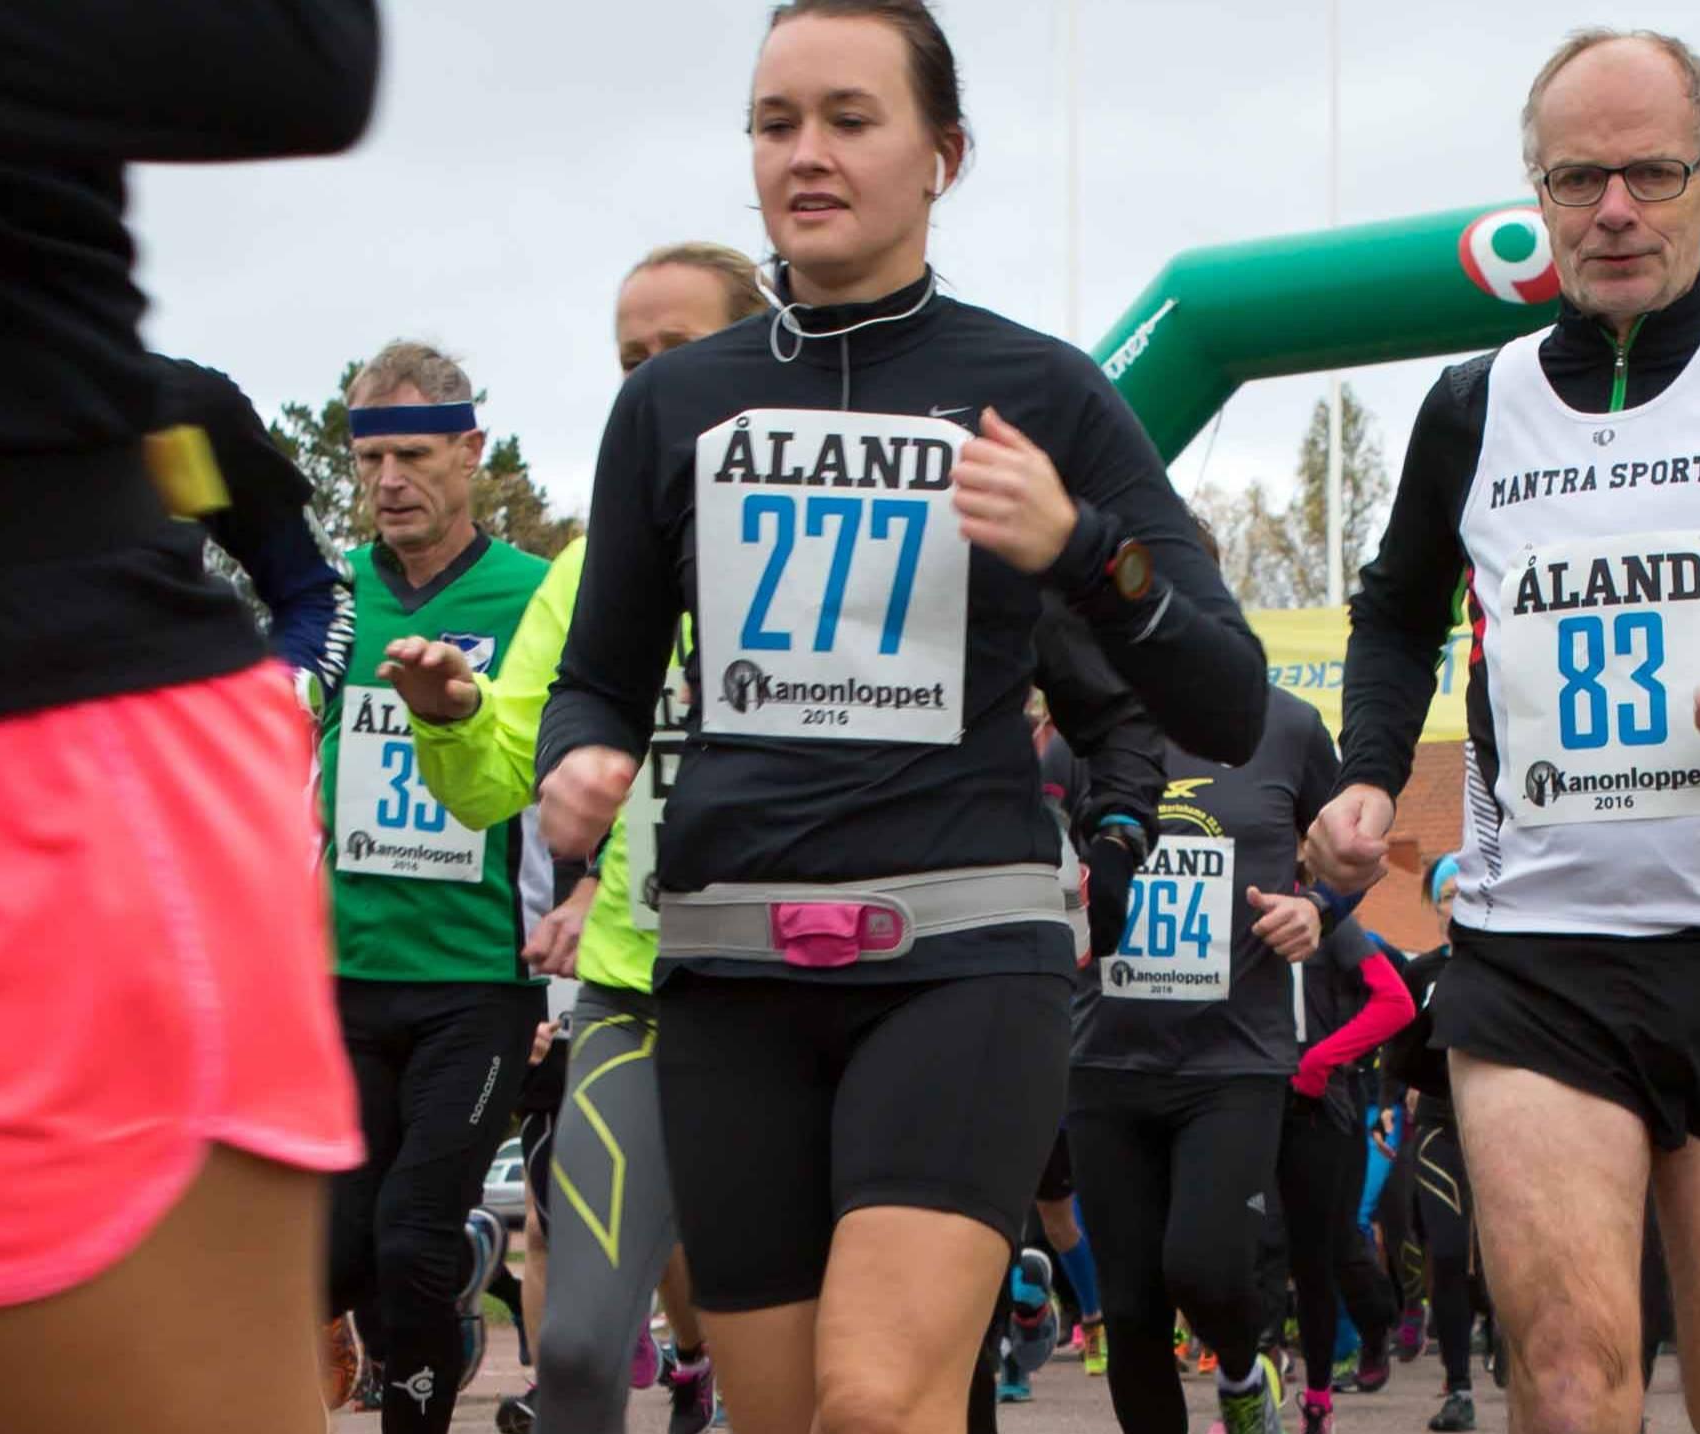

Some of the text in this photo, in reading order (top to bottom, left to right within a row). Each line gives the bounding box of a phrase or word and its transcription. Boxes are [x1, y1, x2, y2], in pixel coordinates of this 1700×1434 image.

[715, 416, 953, 490] ÅLAND
[1490, 466, 1597, 509] MANTRA
[741, 494, 929, 655] 277
[755, 676, 944, 708] Kanonloppet
[1558, 612, 1668, 751] 83
[802, 709, 850, 725] 2016
[1594, 796, 1635, 812] 2016
[365, 838, 474, 866] Kanonloppet
[1117, 879, 1213, 959] 264
[469, 1055, 501, 1126] noname
